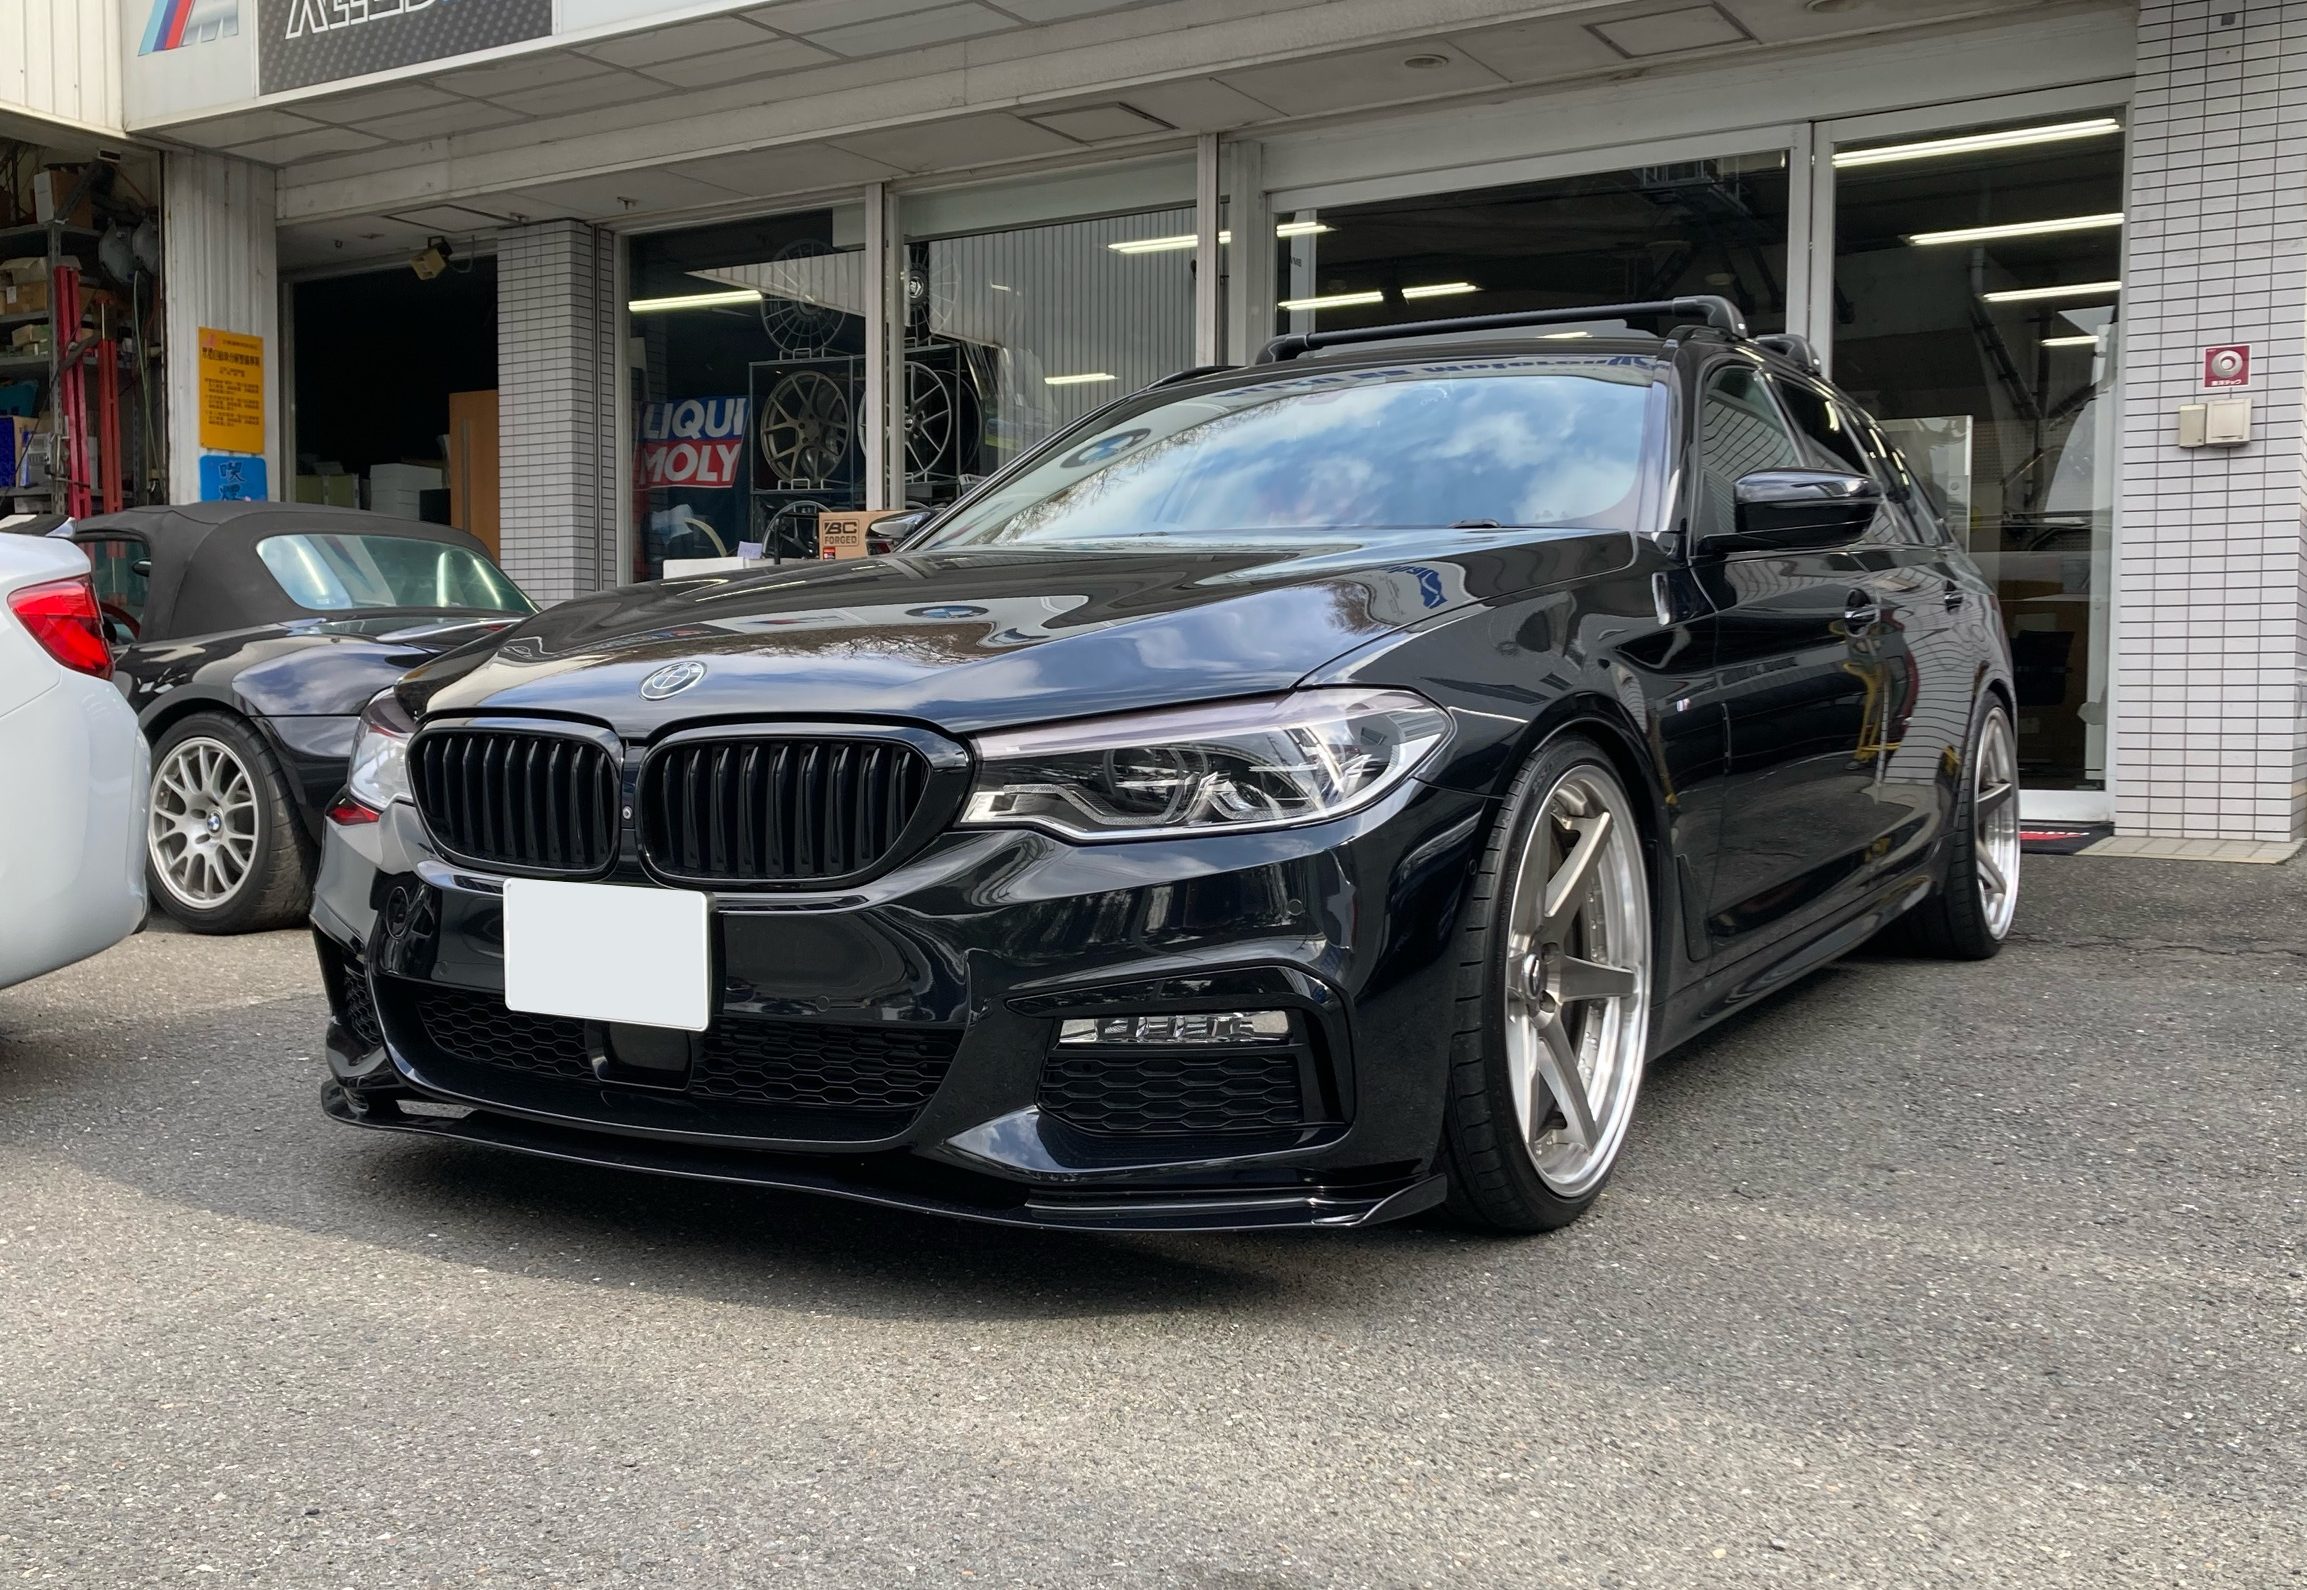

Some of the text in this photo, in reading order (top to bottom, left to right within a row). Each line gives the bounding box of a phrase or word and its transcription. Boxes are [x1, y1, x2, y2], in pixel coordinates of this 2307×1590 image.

[643, 398, 747, 440] LIQUI
[639, 443, 742, 485] MOLY
[824, 521, 857, 534] BC
[824, 536, 858, 545] FORGED
